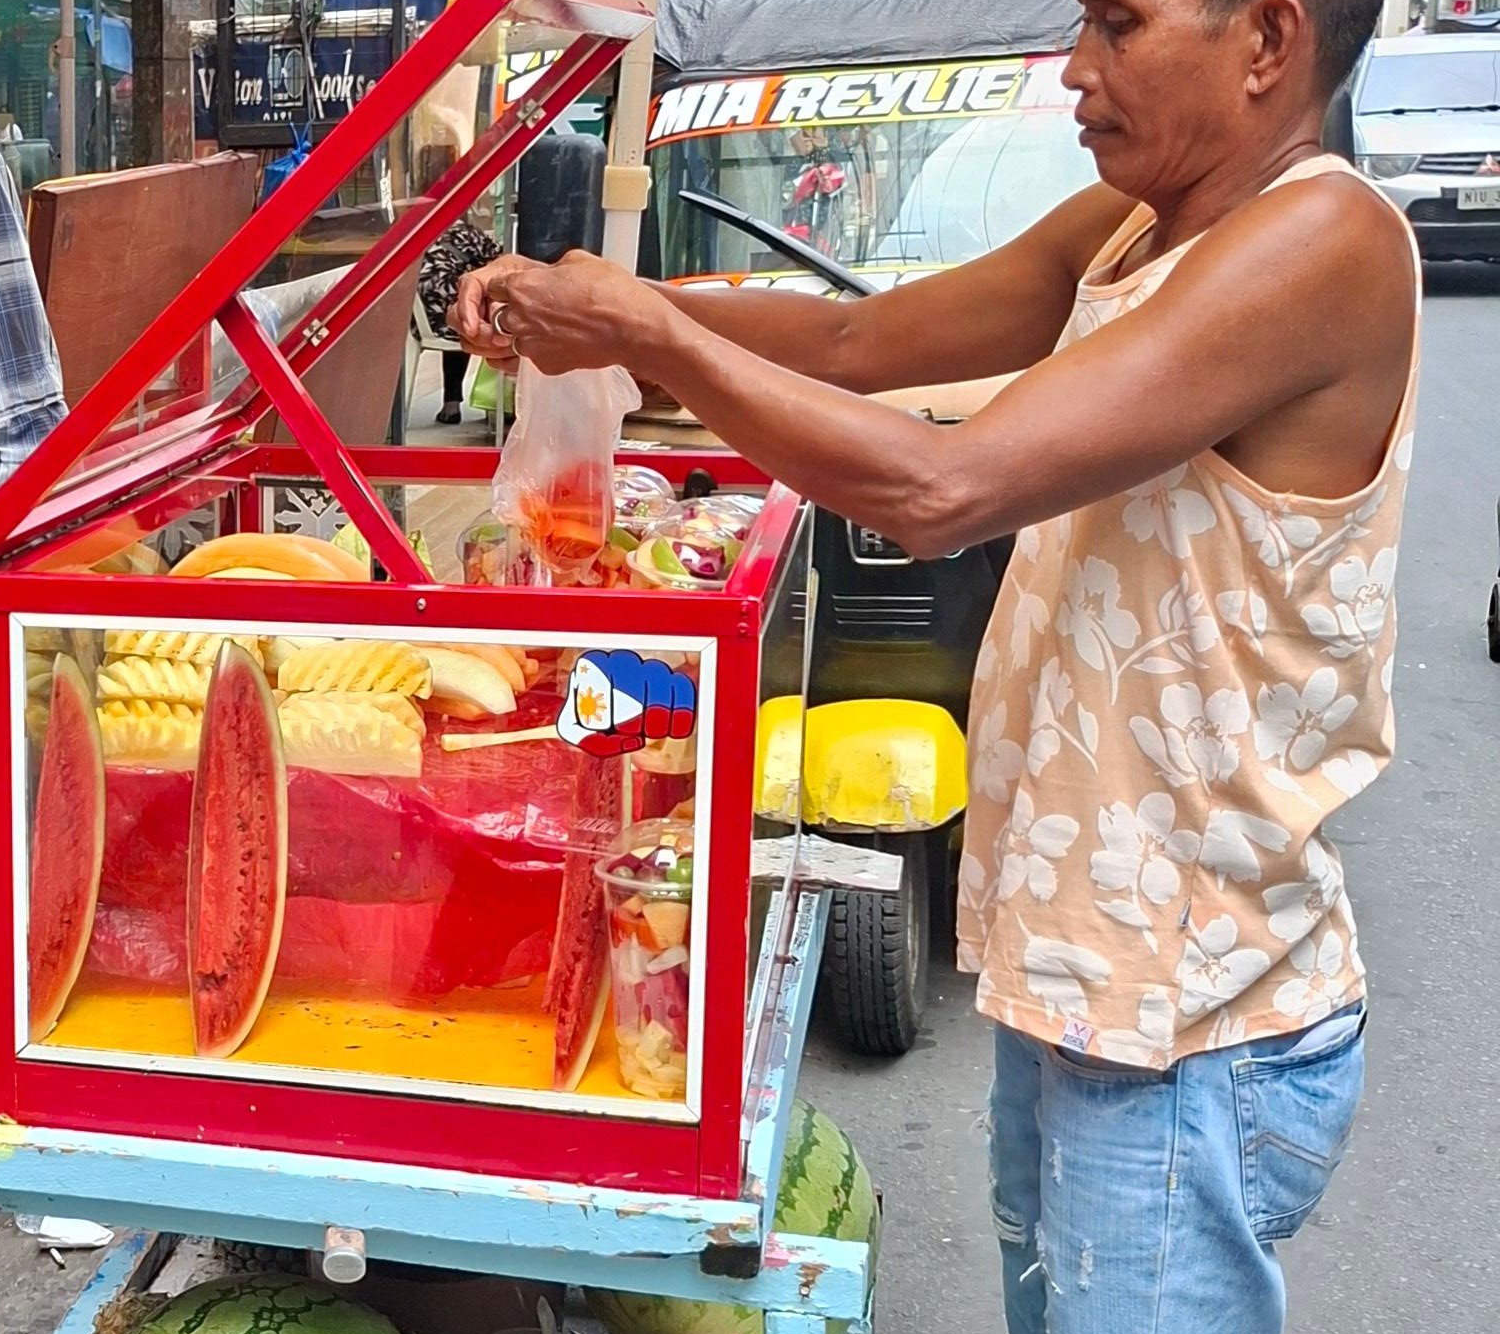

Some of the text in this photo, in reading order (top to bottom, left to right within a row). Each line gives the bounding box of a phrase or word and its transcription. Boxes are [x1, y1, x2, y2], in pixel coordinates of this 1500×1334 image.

[648, 79, 767, 143] MIA
[768, 62, 1023, 123] REYLIE
[1464, 190, 1488, 204] NIU
